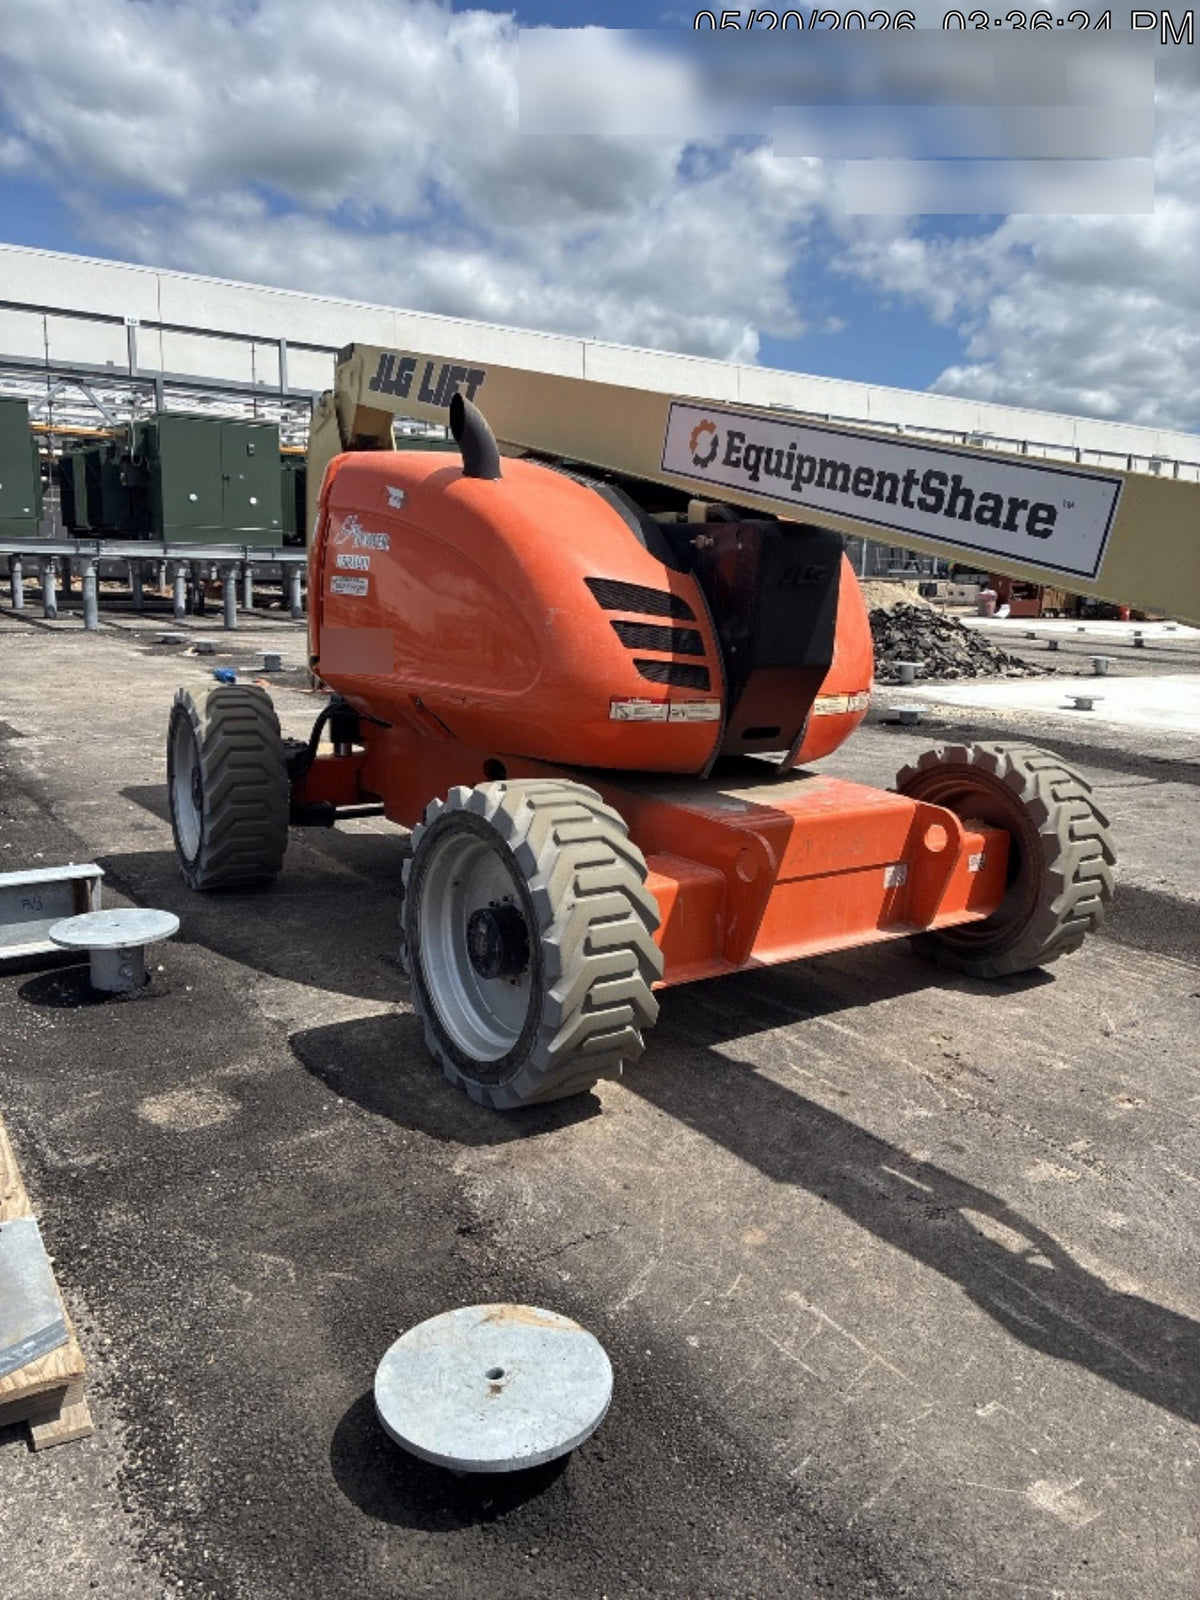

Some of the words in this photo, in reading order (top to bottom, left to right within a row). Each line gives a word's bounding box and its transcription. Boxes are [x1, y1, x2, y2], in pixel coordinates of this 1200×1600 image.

[368, 353, 418, 399] JLG
[417, 361, 486, 408] LIFT
[722, 430, 1057, 540] EquipmentShare
